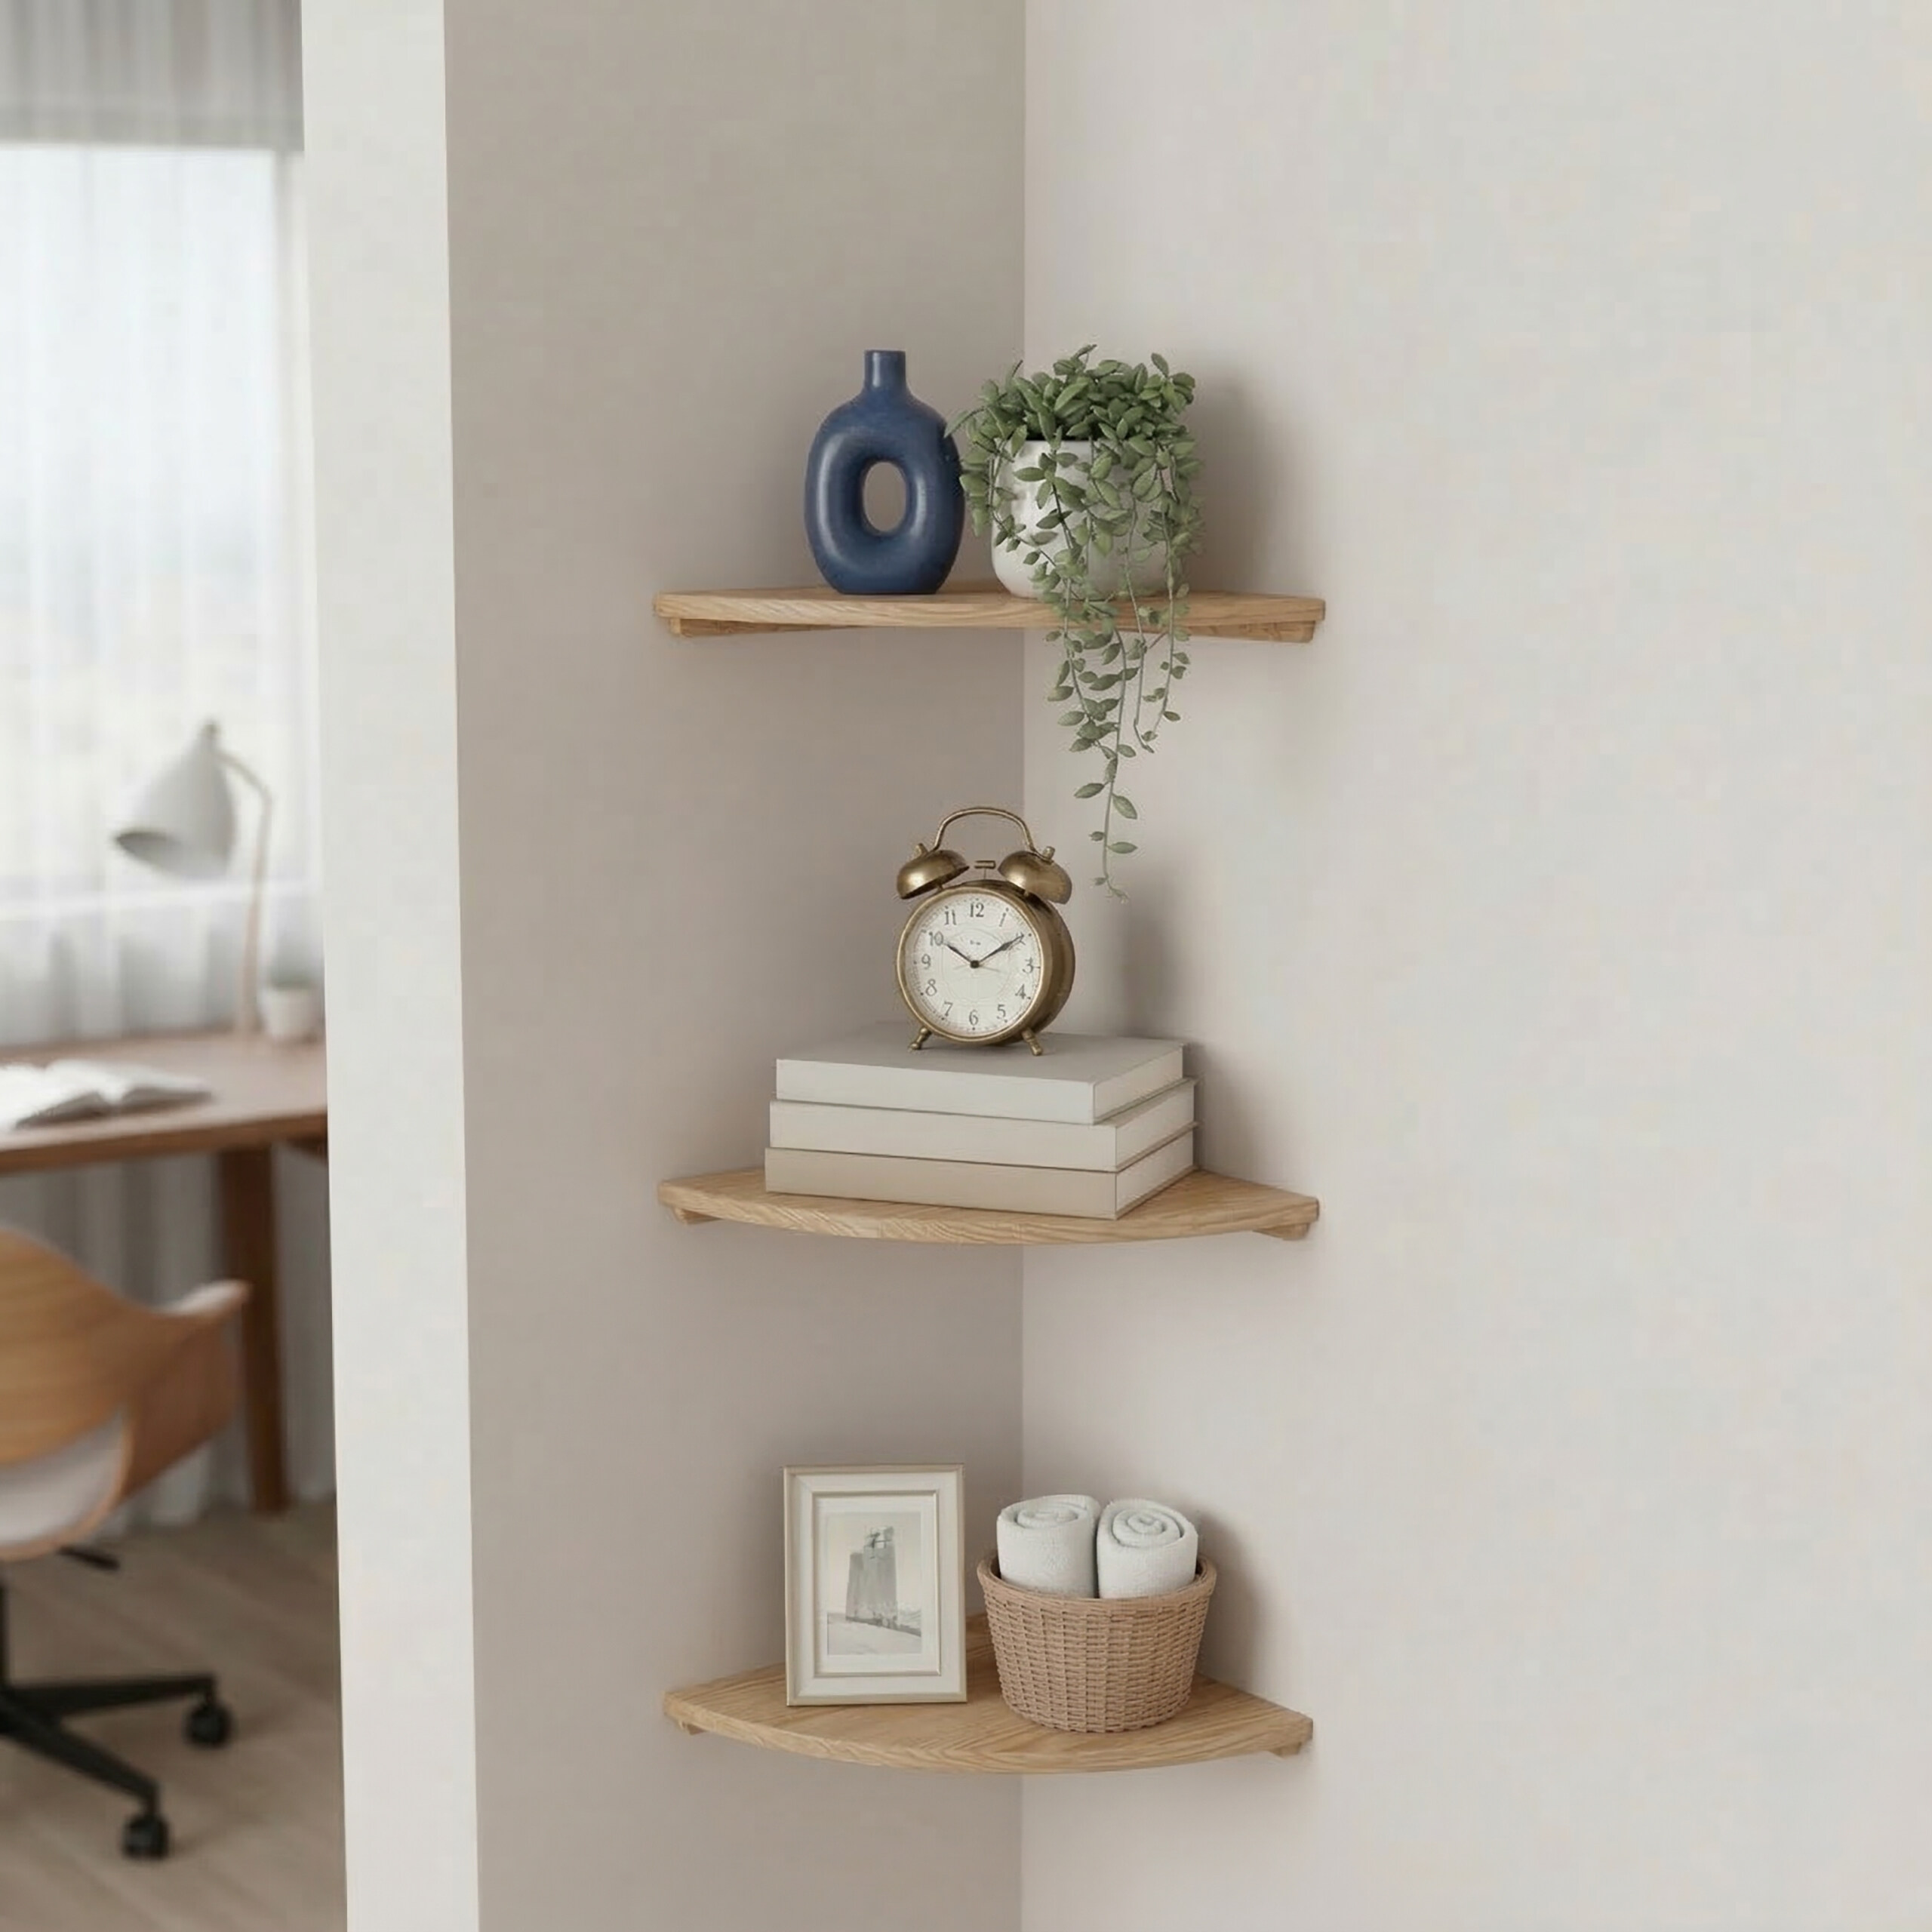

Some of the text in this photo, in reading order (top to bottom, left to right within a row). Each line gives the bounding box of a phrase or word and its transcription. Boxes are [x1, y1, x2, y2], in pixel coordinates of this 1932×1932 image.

[944, 909, 957, 925] 11
[970, 902, 984, 918] 12
[928, 931, 944, 946] 10
[921, 953, 931, 970] 9
[1022, 957, 1034, 974] 3
[925, 978, 937, 996] 8
[1015, 983, 1026, 1000] 4
[944, 1001, 953, 1017] 7
[996, 1004, 1006, 1020] 5
[969, 1009, 979, 1026] 6
